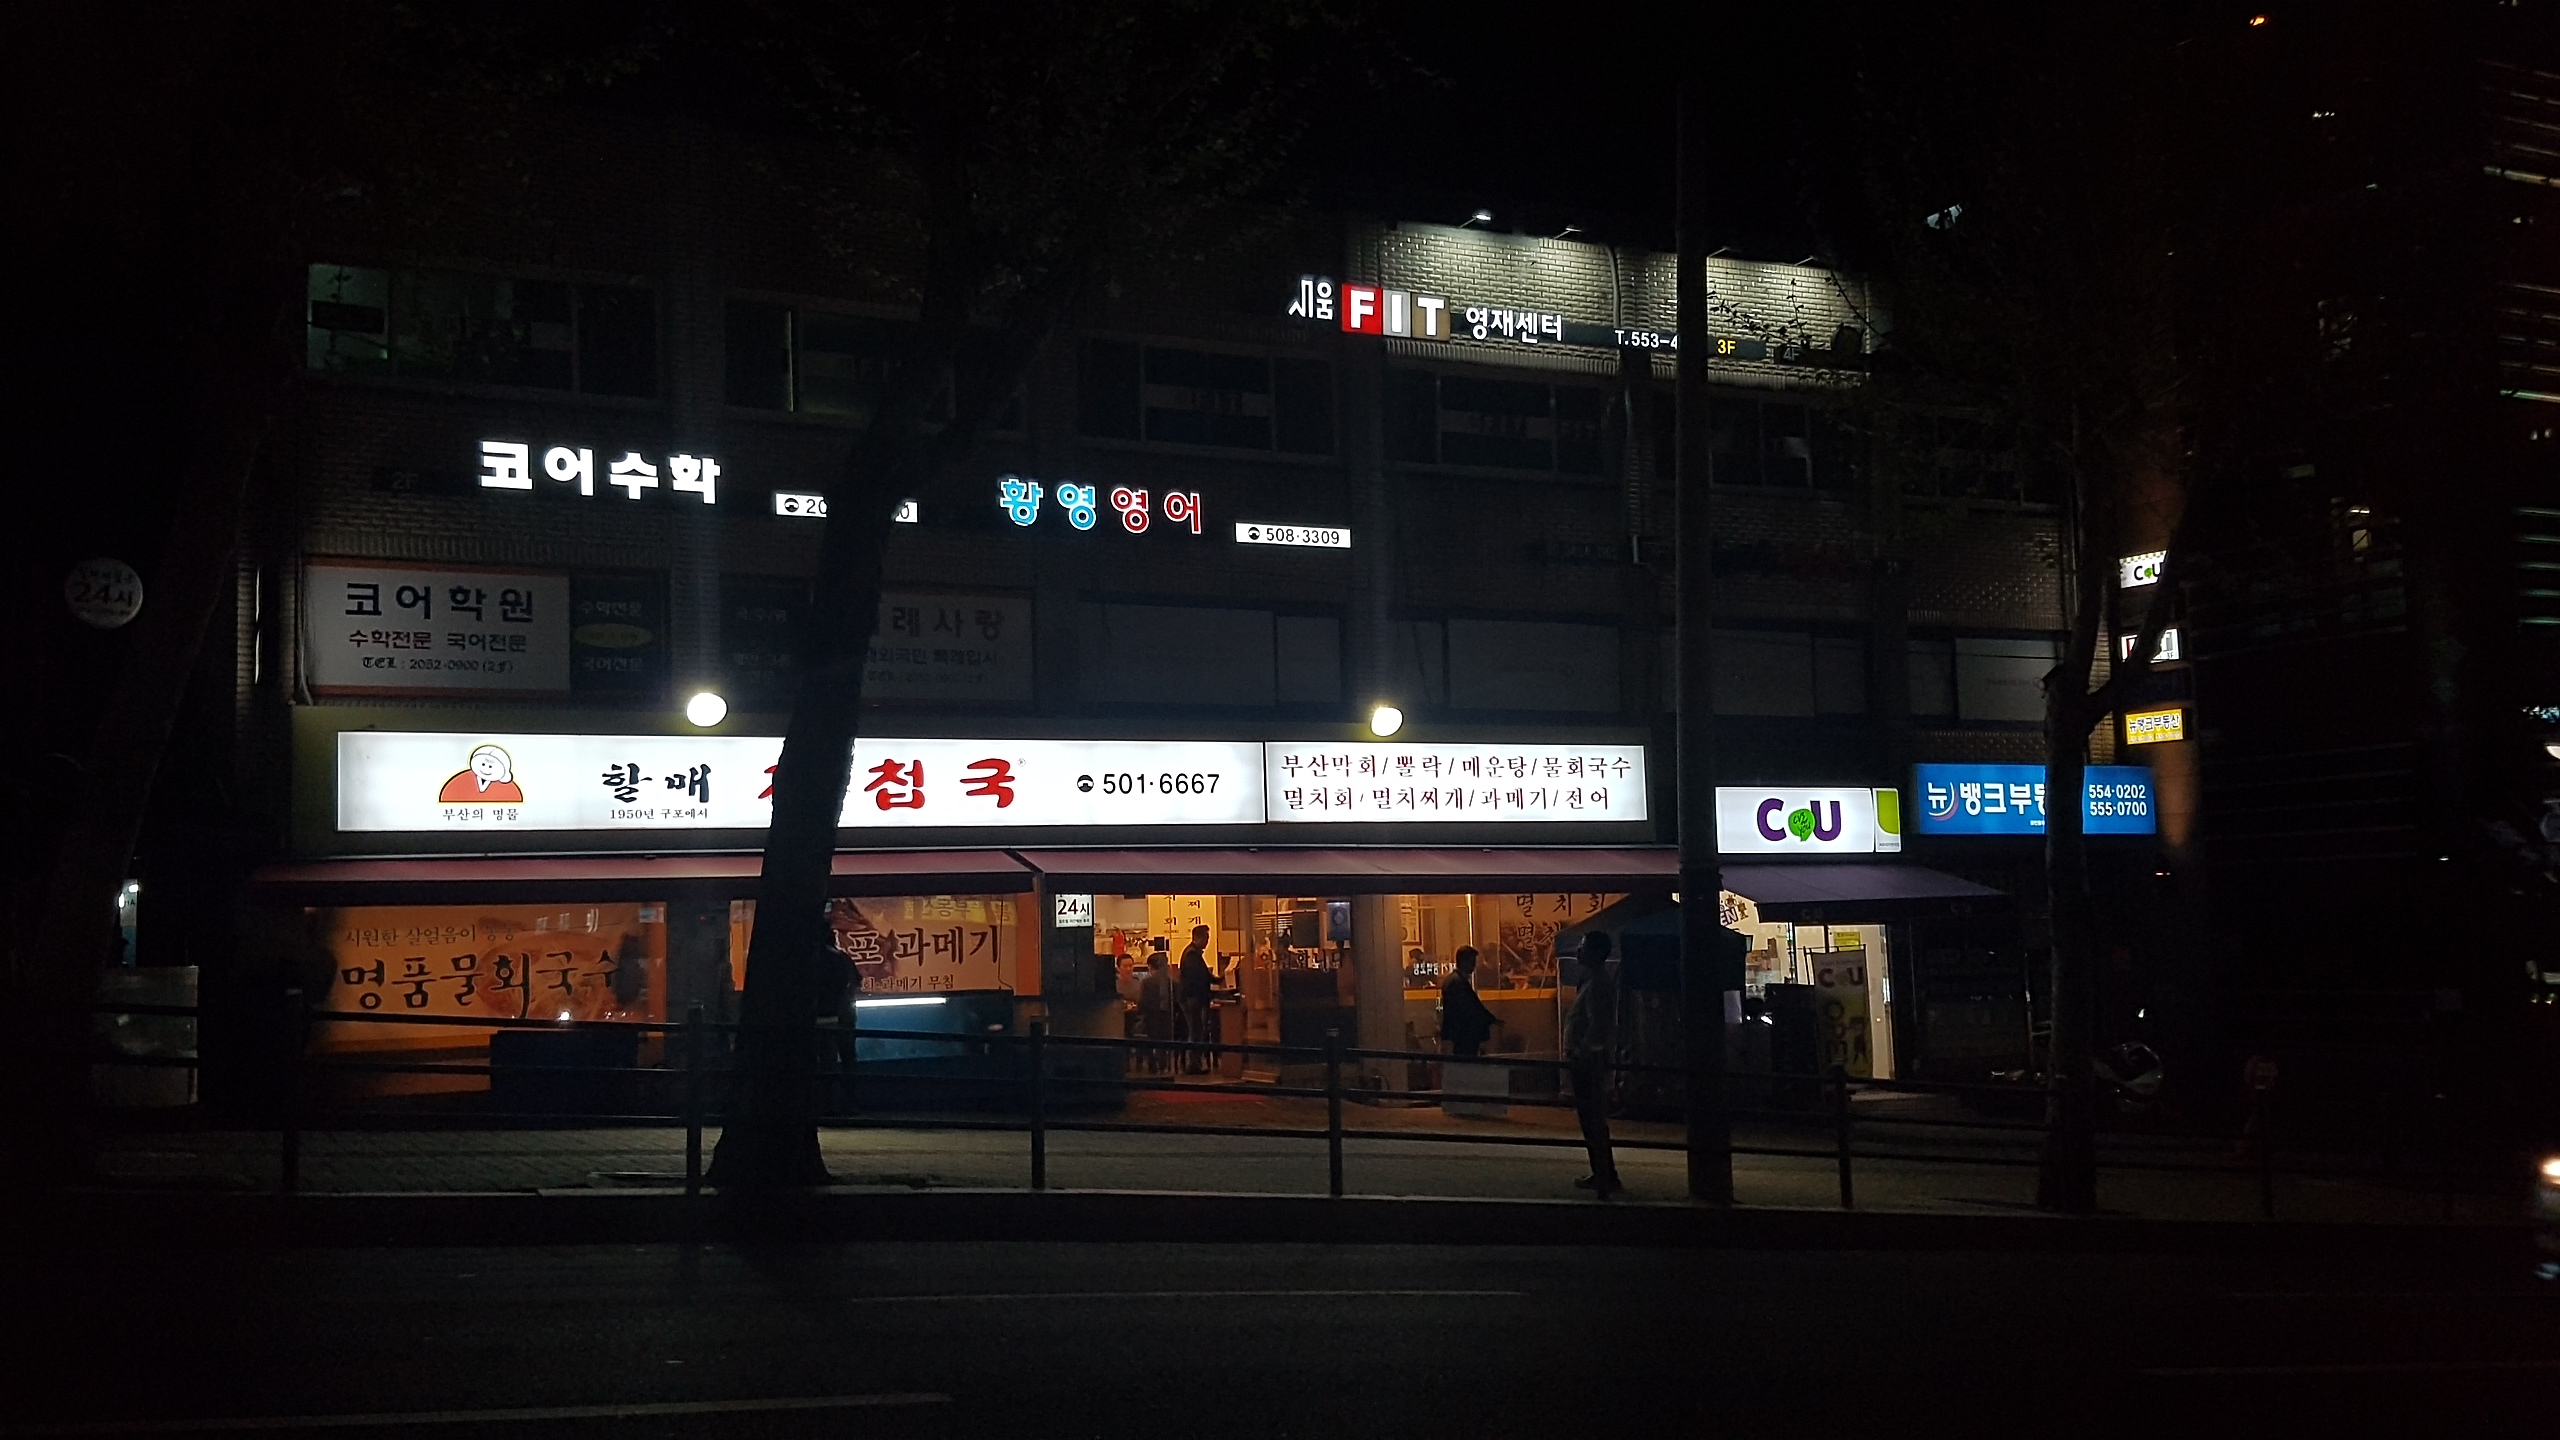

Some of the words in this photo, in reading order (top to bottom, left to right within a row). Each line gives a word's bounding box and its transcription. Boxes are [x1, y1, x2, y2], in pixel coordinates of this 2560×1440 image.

[1350, 289, 1445, 337] FIT
[1464, 306, 1564, 344] 영재센터
[1615, 330, 1678, 350] T.553-4
[1717, 338, 1737, 355] 3F
[480, 440, 721, 504] 코어수학
[345, 582, 534, 624] 코어학원
[878, 605, 1005, 642] 레사랑
[349, 630, 433, 651] 수학전문
[446, 632, 528, 653] 국어전문
[758, 758, 1016, 810] 첩국
[442, 808, 484, 821] 부산의
[609, 808, 655, 821] 1950년
[1757, 797, 1841, 842] CU
[1057, 898, 1091, 917] 24시
[344, 927, 399, 948] 시원한
[892, 924, 999, 967] 과메기
[341, 949, 622, 1020] 명품물회국수
[926, 973, 955, 991] 무침
[1818, 966, 1864, 988] CU
